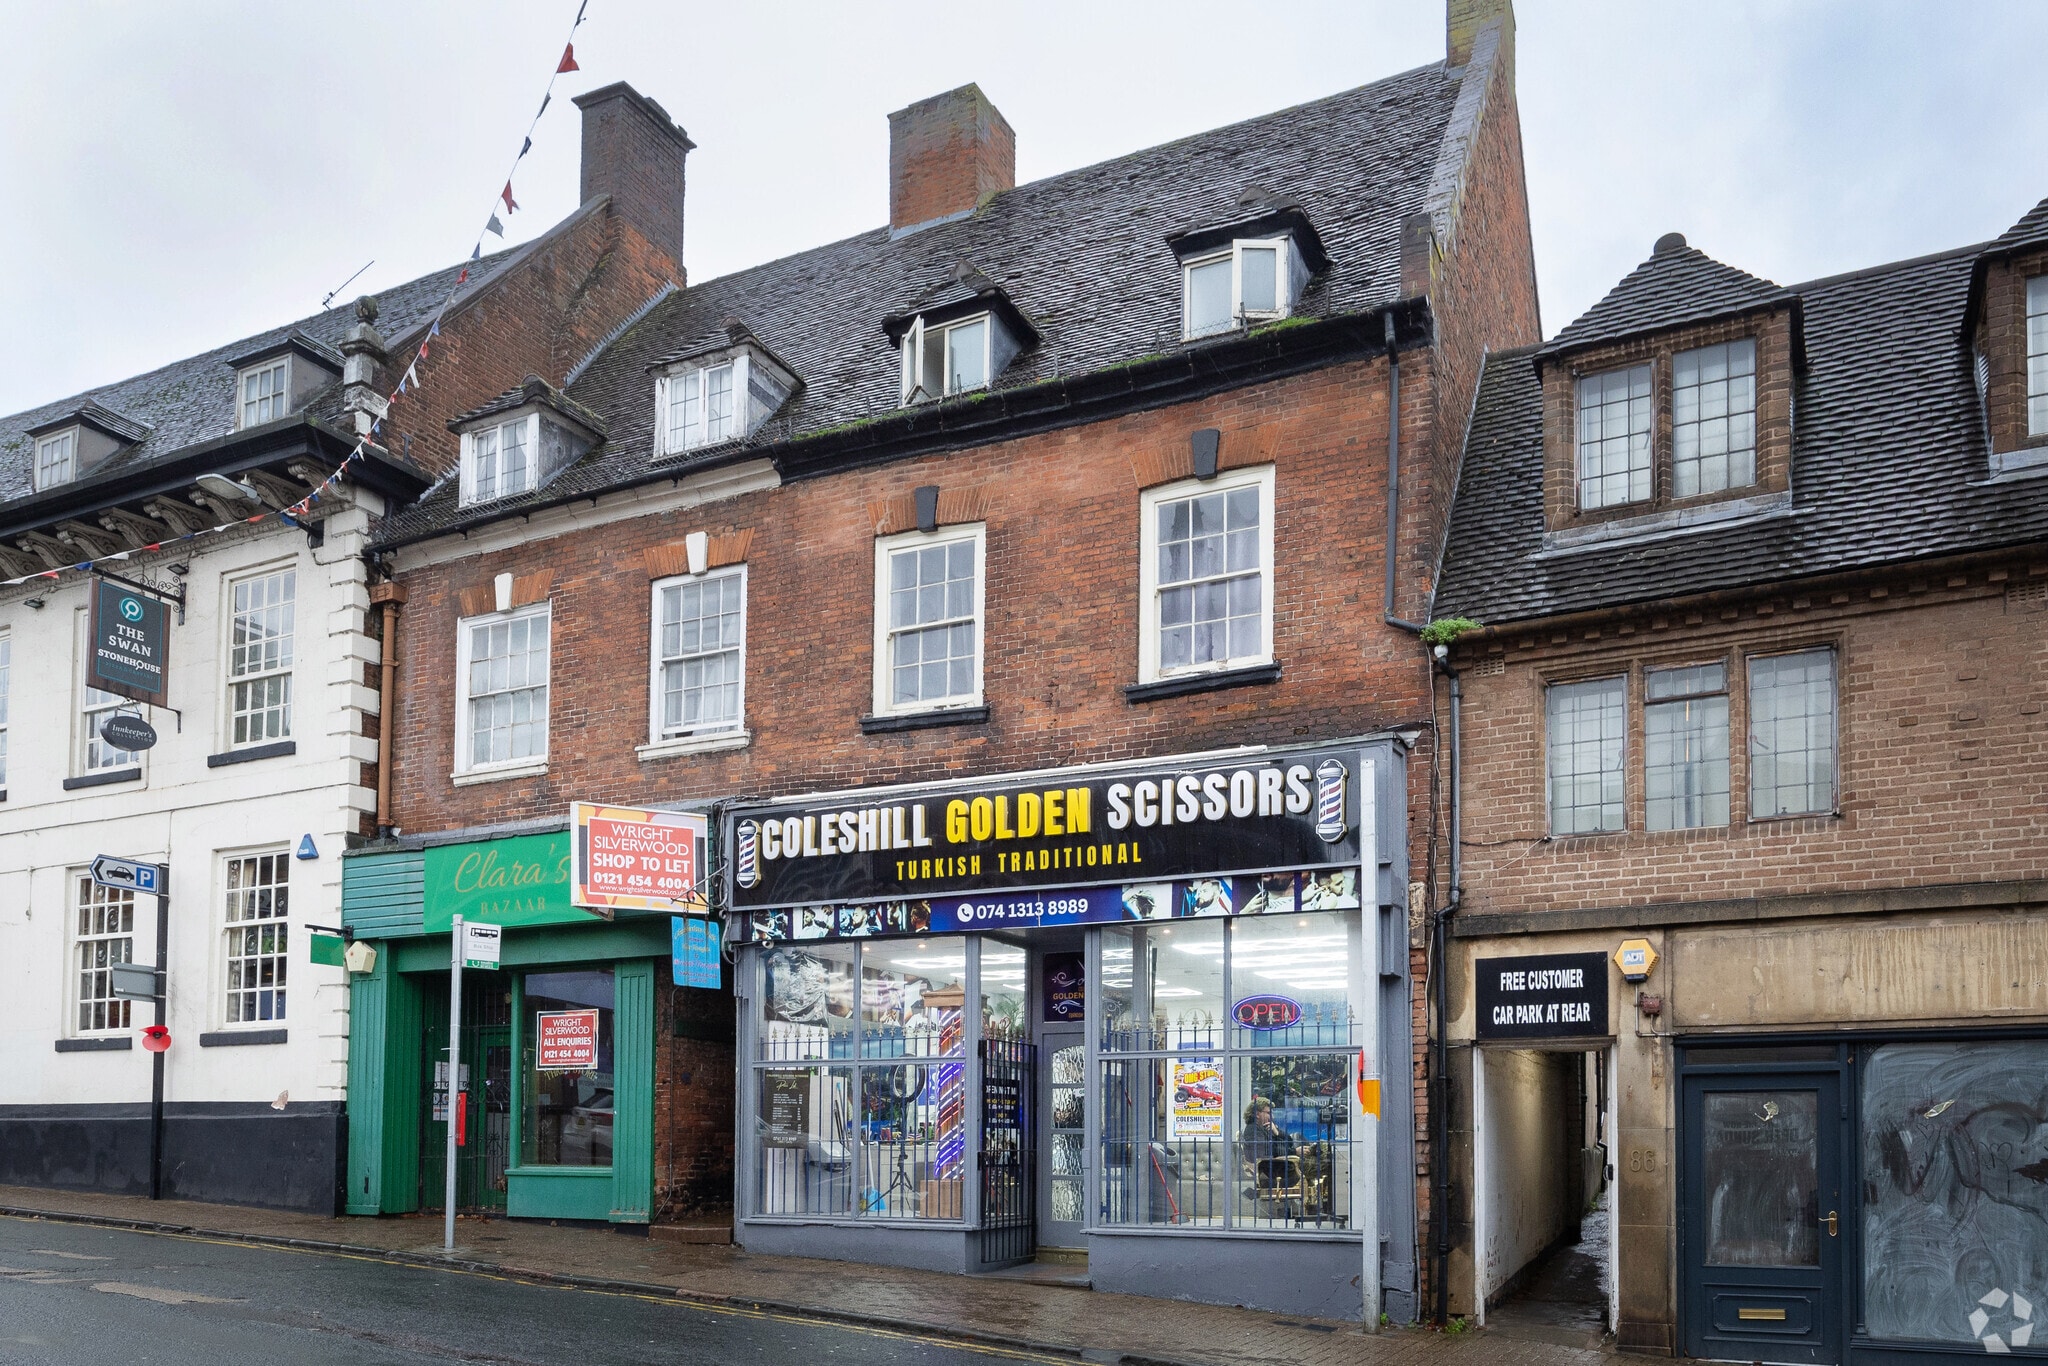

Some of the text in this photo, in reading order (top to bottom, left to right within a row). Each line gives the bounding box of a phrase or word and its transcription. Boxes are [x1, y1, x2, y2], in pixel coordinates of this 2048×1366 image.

[116, 623, 145, 642] THE
[108, 635, 152, 657] SWAN
[98, 648, 161, 674] STONEHOUSE
[112, 724, 153, 739] Innkeeper's
[762, 765, 1313, 860] COLESHILL GOLDEN SCISSORS
[611, 823, 673, 841] WRIGHT
[594, 835, 689, 856] SILVERWOOD
[455, 842, 571, 892] Clara's
[593, 853, 690, 874] SHOP TO LET
[896, 842, 1142, 881] TURKISH TRADITIONAL
[140, 870, 151, 885] P
[593, 871, 690, 890] 0121 454 4004
[481, 897, 545, 915] BAZAAR
[976, 898, 1088, 920] 074 1313 8989
[1624, 952, 1644, 963] ADT
[1500, 969, 1583, 991] FREE CUSTOMER
[1053, 992, 1085, 1000] GOLDEN
[1239, 1003, 1296, 1022] OPEN
[1493, 1002, 1590, 1025] CAR PARK AT REAR
[545, 1026, 590, 1035] SILVERWOOD
[552, 1018, 582, 1027] WRIGHT
[543, 1037, 592, 1047] ALL ENQUIRIES
[544, 1049, 590, 1058] 0121 454 4004
[1630, 1149, 1655, 1172] 86
